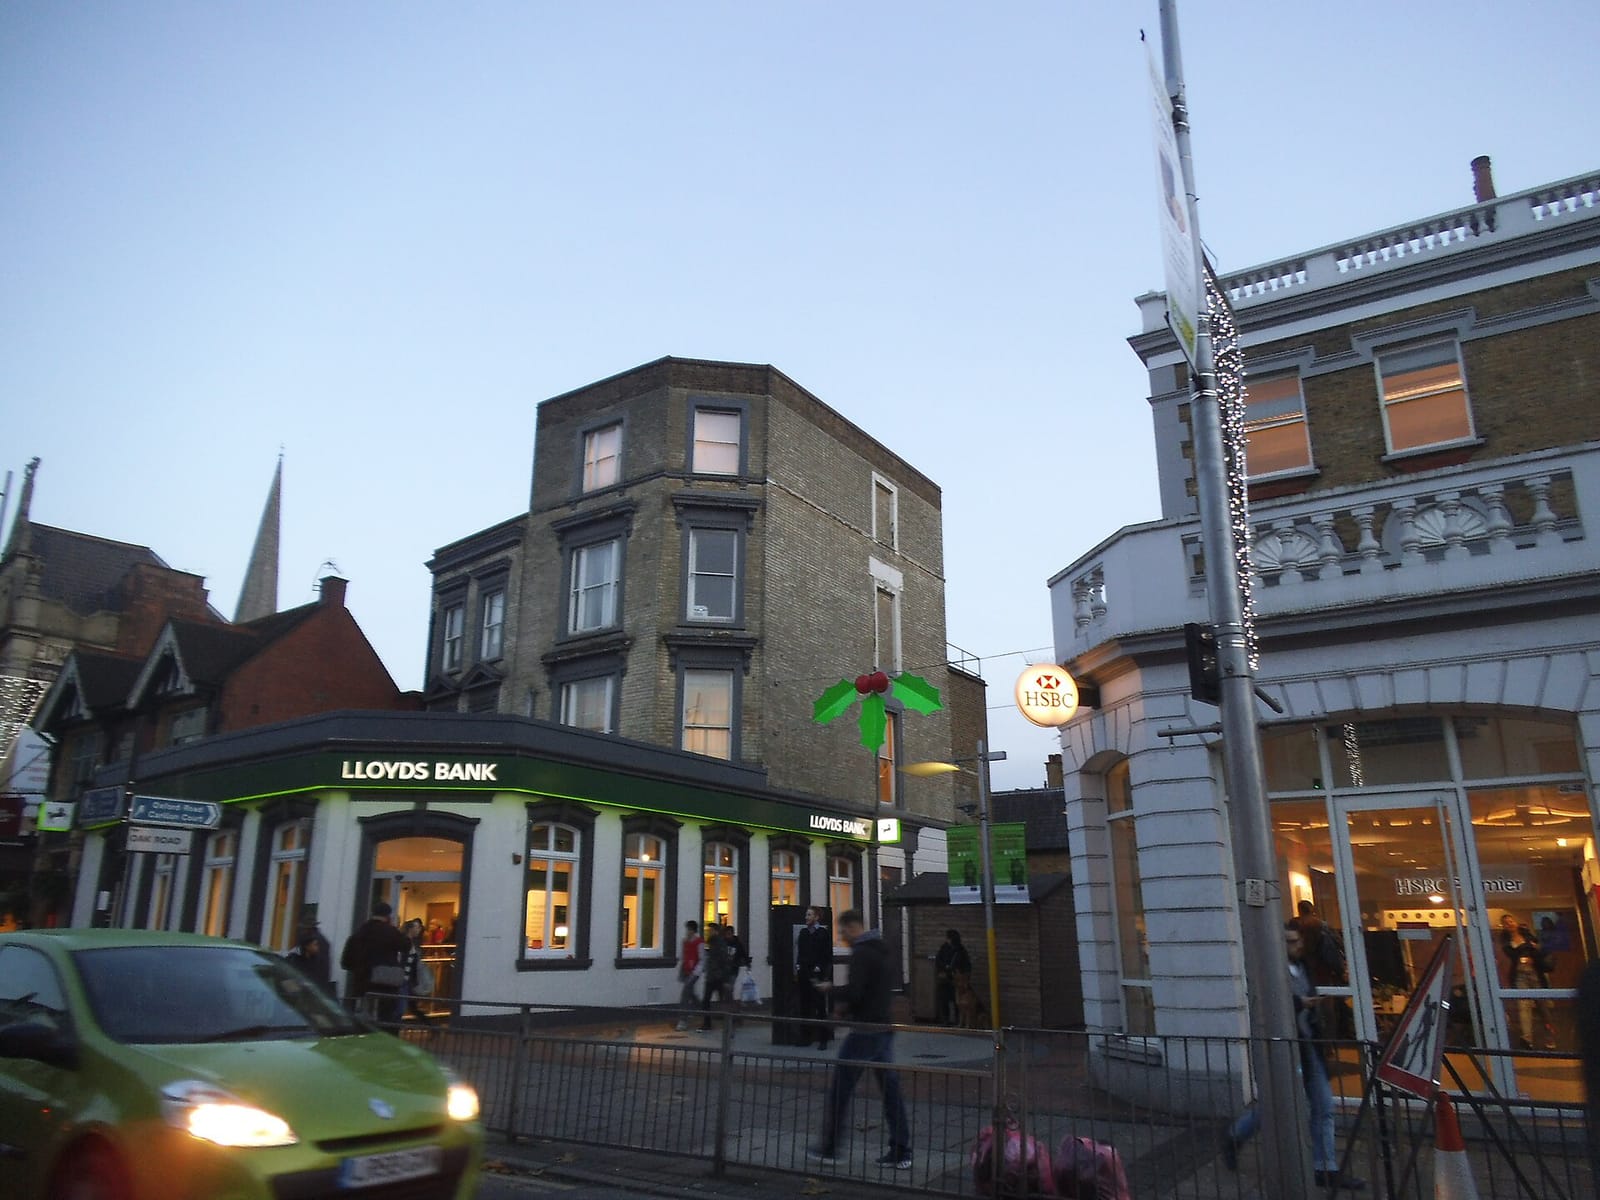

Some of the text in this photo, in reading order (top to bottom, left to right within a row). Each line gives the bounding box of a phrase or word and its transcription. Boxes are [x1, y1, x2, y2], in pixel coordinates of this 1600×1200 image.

[1025, 690, 1073, 708] HSBC
[341, 761, 498, 781] LLOYDS BANK
[183, 804, 204, 813] Road
[809, 815, 867, 836] LLOYDS BANK
[154, 835, 182, 845] ROAD
[1395, 877, 1448, 895] HSBC
